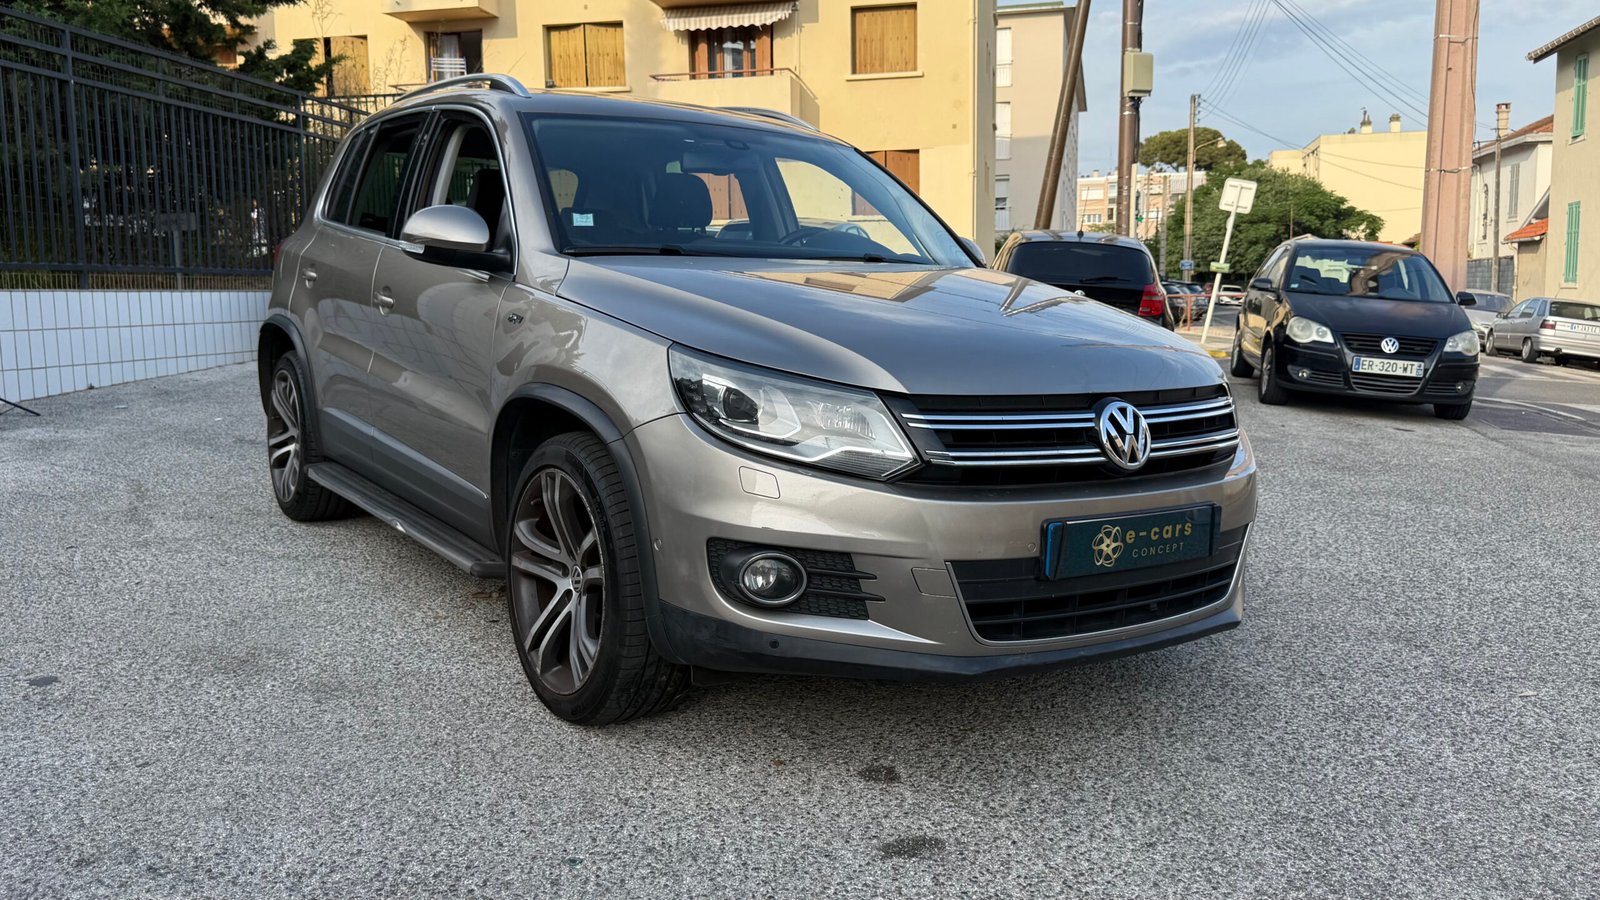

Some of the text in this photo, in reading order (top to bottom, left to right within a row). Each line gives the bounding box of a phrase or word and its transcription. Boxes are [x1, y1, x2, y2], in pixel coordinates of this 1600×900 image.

[1381, 337, 1400, 354] VW
[1360, 359, 1416, 375] ER-320-WT
[1100, 401, 1152, 470] VW
[1125, 521, 1193, 544] e-cars
[1132, 542, 1185, 558] CONCEPT
